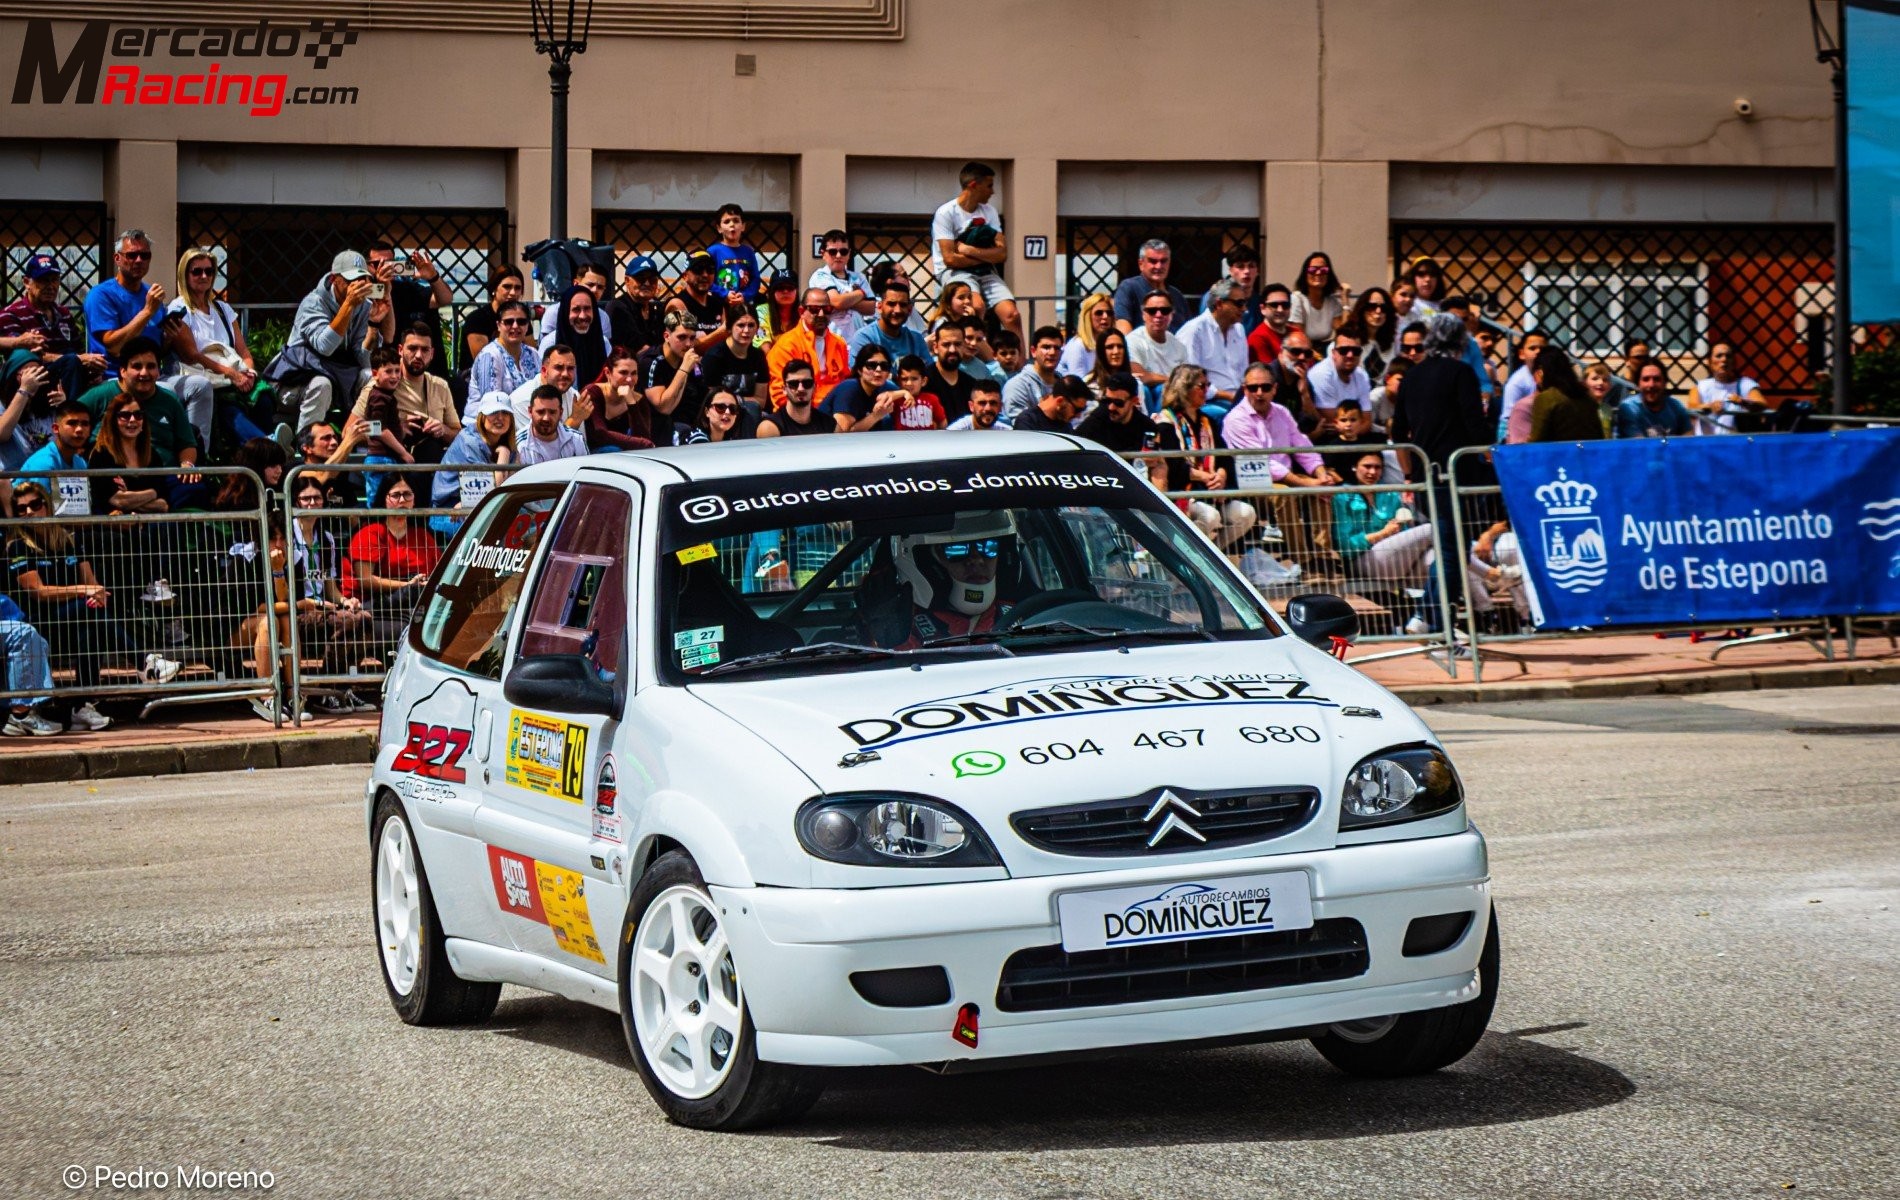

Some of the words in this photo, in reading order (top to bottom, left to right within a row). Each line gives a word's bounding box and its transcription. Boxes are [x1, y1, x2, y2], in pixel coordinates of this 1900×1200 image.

[1027, 240, 1046, 257] 77
[732, 471, 1123, 513] autorecambios_dominguez
[1621, 508, 1833, 553] Ayuntamiento
[1640, 557, 1676, 591] de
[1684, 556, 1828, 594] Estepona
[700, 630, 716, 640] 27
[1048, 673, 1303, 693] AUTORECAMBIOS
[518, 722, 566, 764] ESTEPONA
[565, 726, 585, 796] 79
[1019, 738, 1105, 766] 604
[1133, 728, 1206, 750] 467
[1238, 725, 1321, 744] 680
[499, 855, 528, 889] AUTO
[505, 879, 532, 909] SPORT
[1179, 887, 1271, 906] AUTORECAMBIOS
